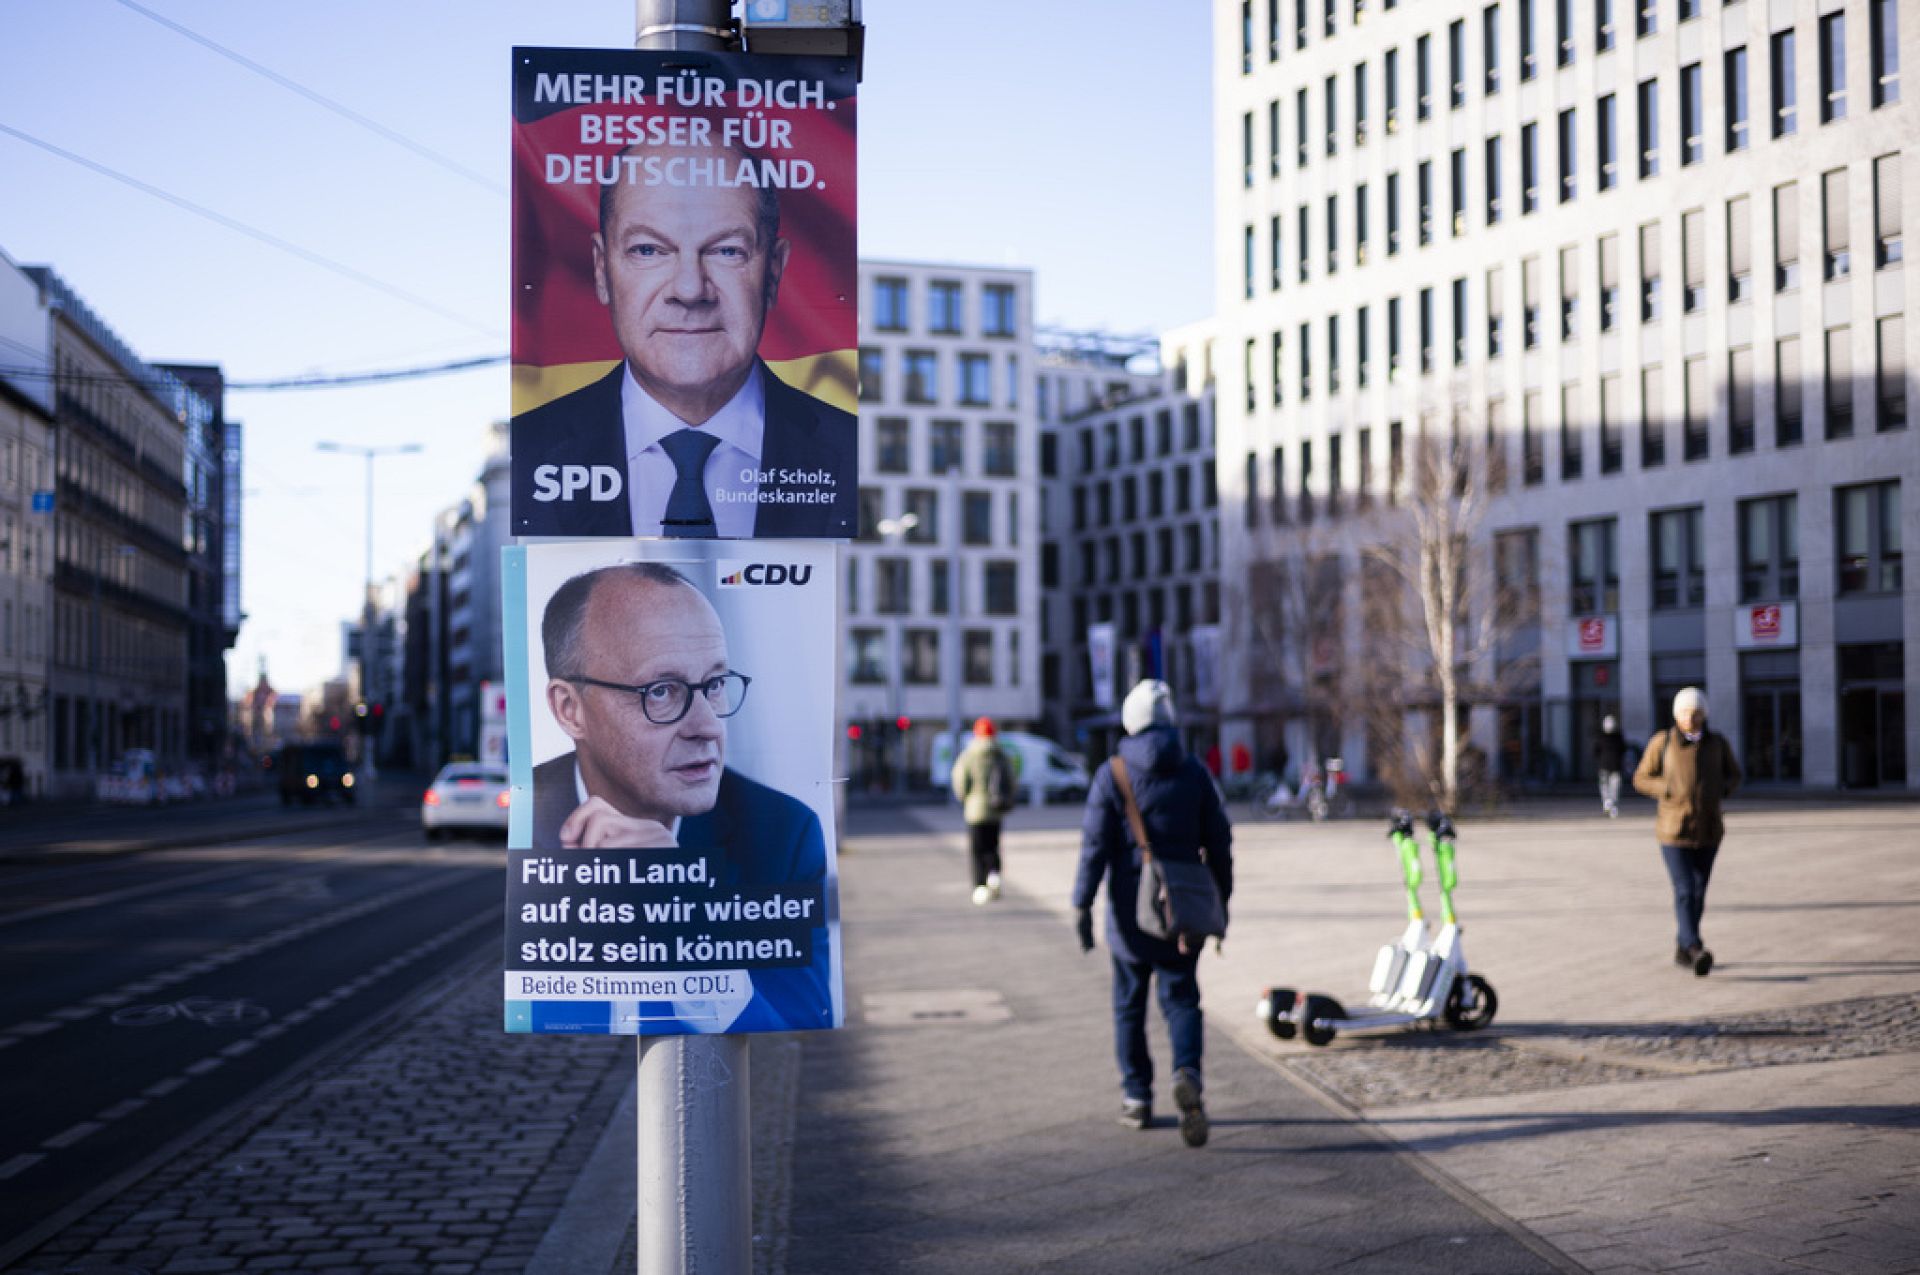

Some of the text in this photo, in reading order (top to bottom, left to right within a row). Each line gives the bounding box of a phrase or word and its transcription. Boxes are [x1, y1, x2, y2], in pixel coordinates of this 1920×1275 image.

[534, 69, 836, 110] MEHR FÜR DICH.
[580, 111, 793, 149] BESSER FÜR
[545, 154, 826, 190] DEUTSCHLAND.
[532, 464, 623, 502] SPD
[740, 469, 837, 487] Olaf Scholz,
[716, 488, 837, 504] Bundeskanzler
[743, 564, 812, 586] CDU
[521, 857, 716, 888] Für ein Land,
[521, 894, 814, 923] auf das wir wieder
[521, 935, 802, 962] stolz sein können.
[521, 976, 735, 995] Beide Stimmen CDU.
